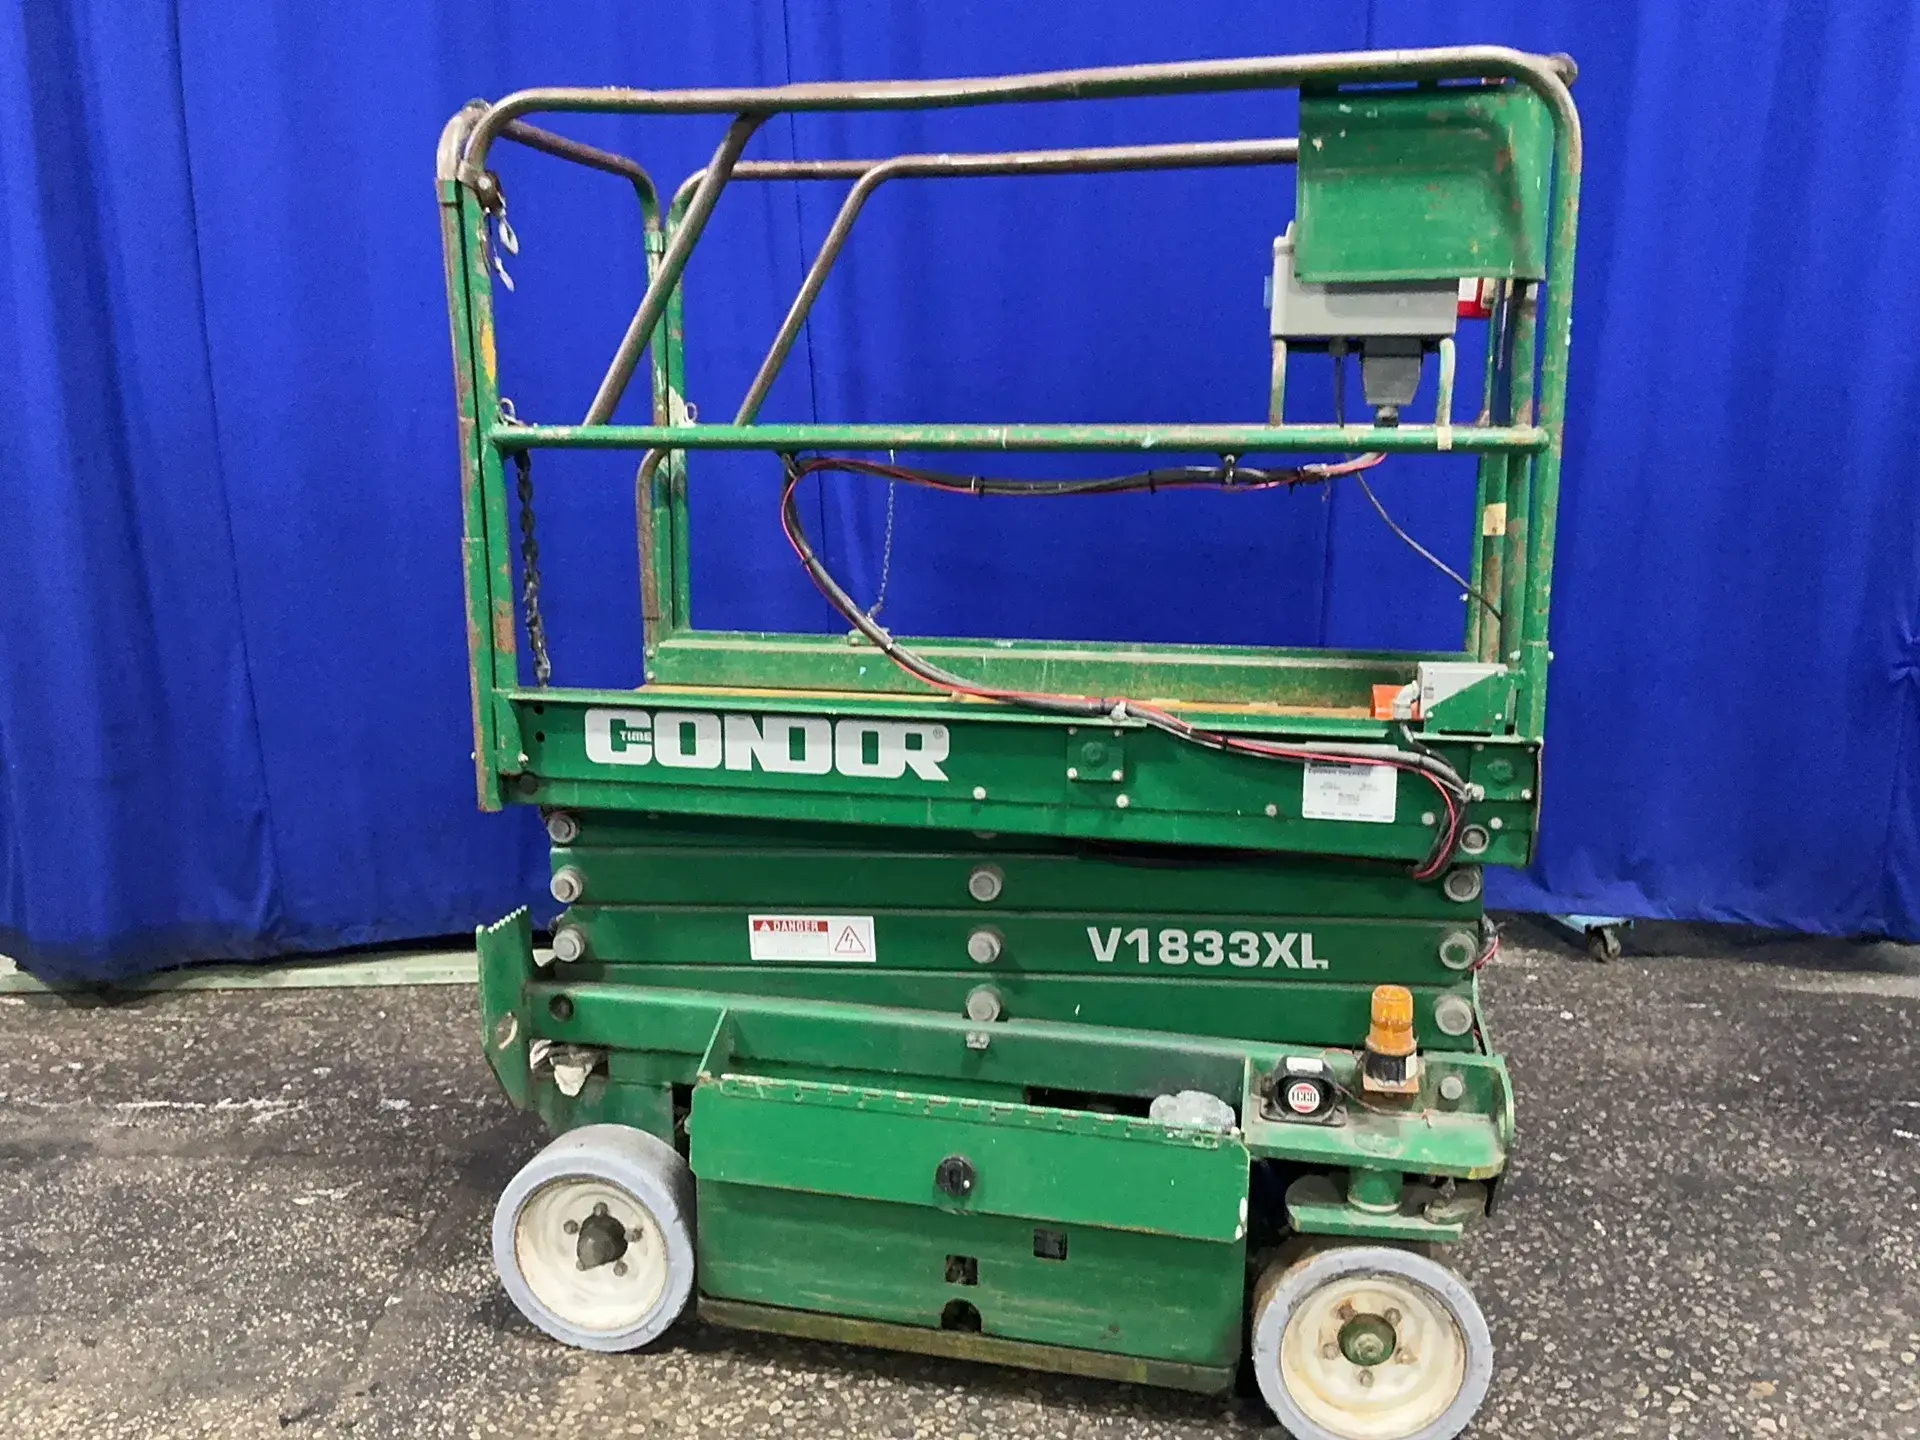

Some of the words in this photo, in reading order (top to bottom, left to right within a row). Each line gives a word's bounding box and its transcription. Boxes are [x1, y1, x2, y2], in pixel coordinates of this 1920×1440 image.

[585, 708, 949, 781] CONDOR
[773, 920, 819, 932] DANGER
[1086, 927, 1329, 970] V1833XL
